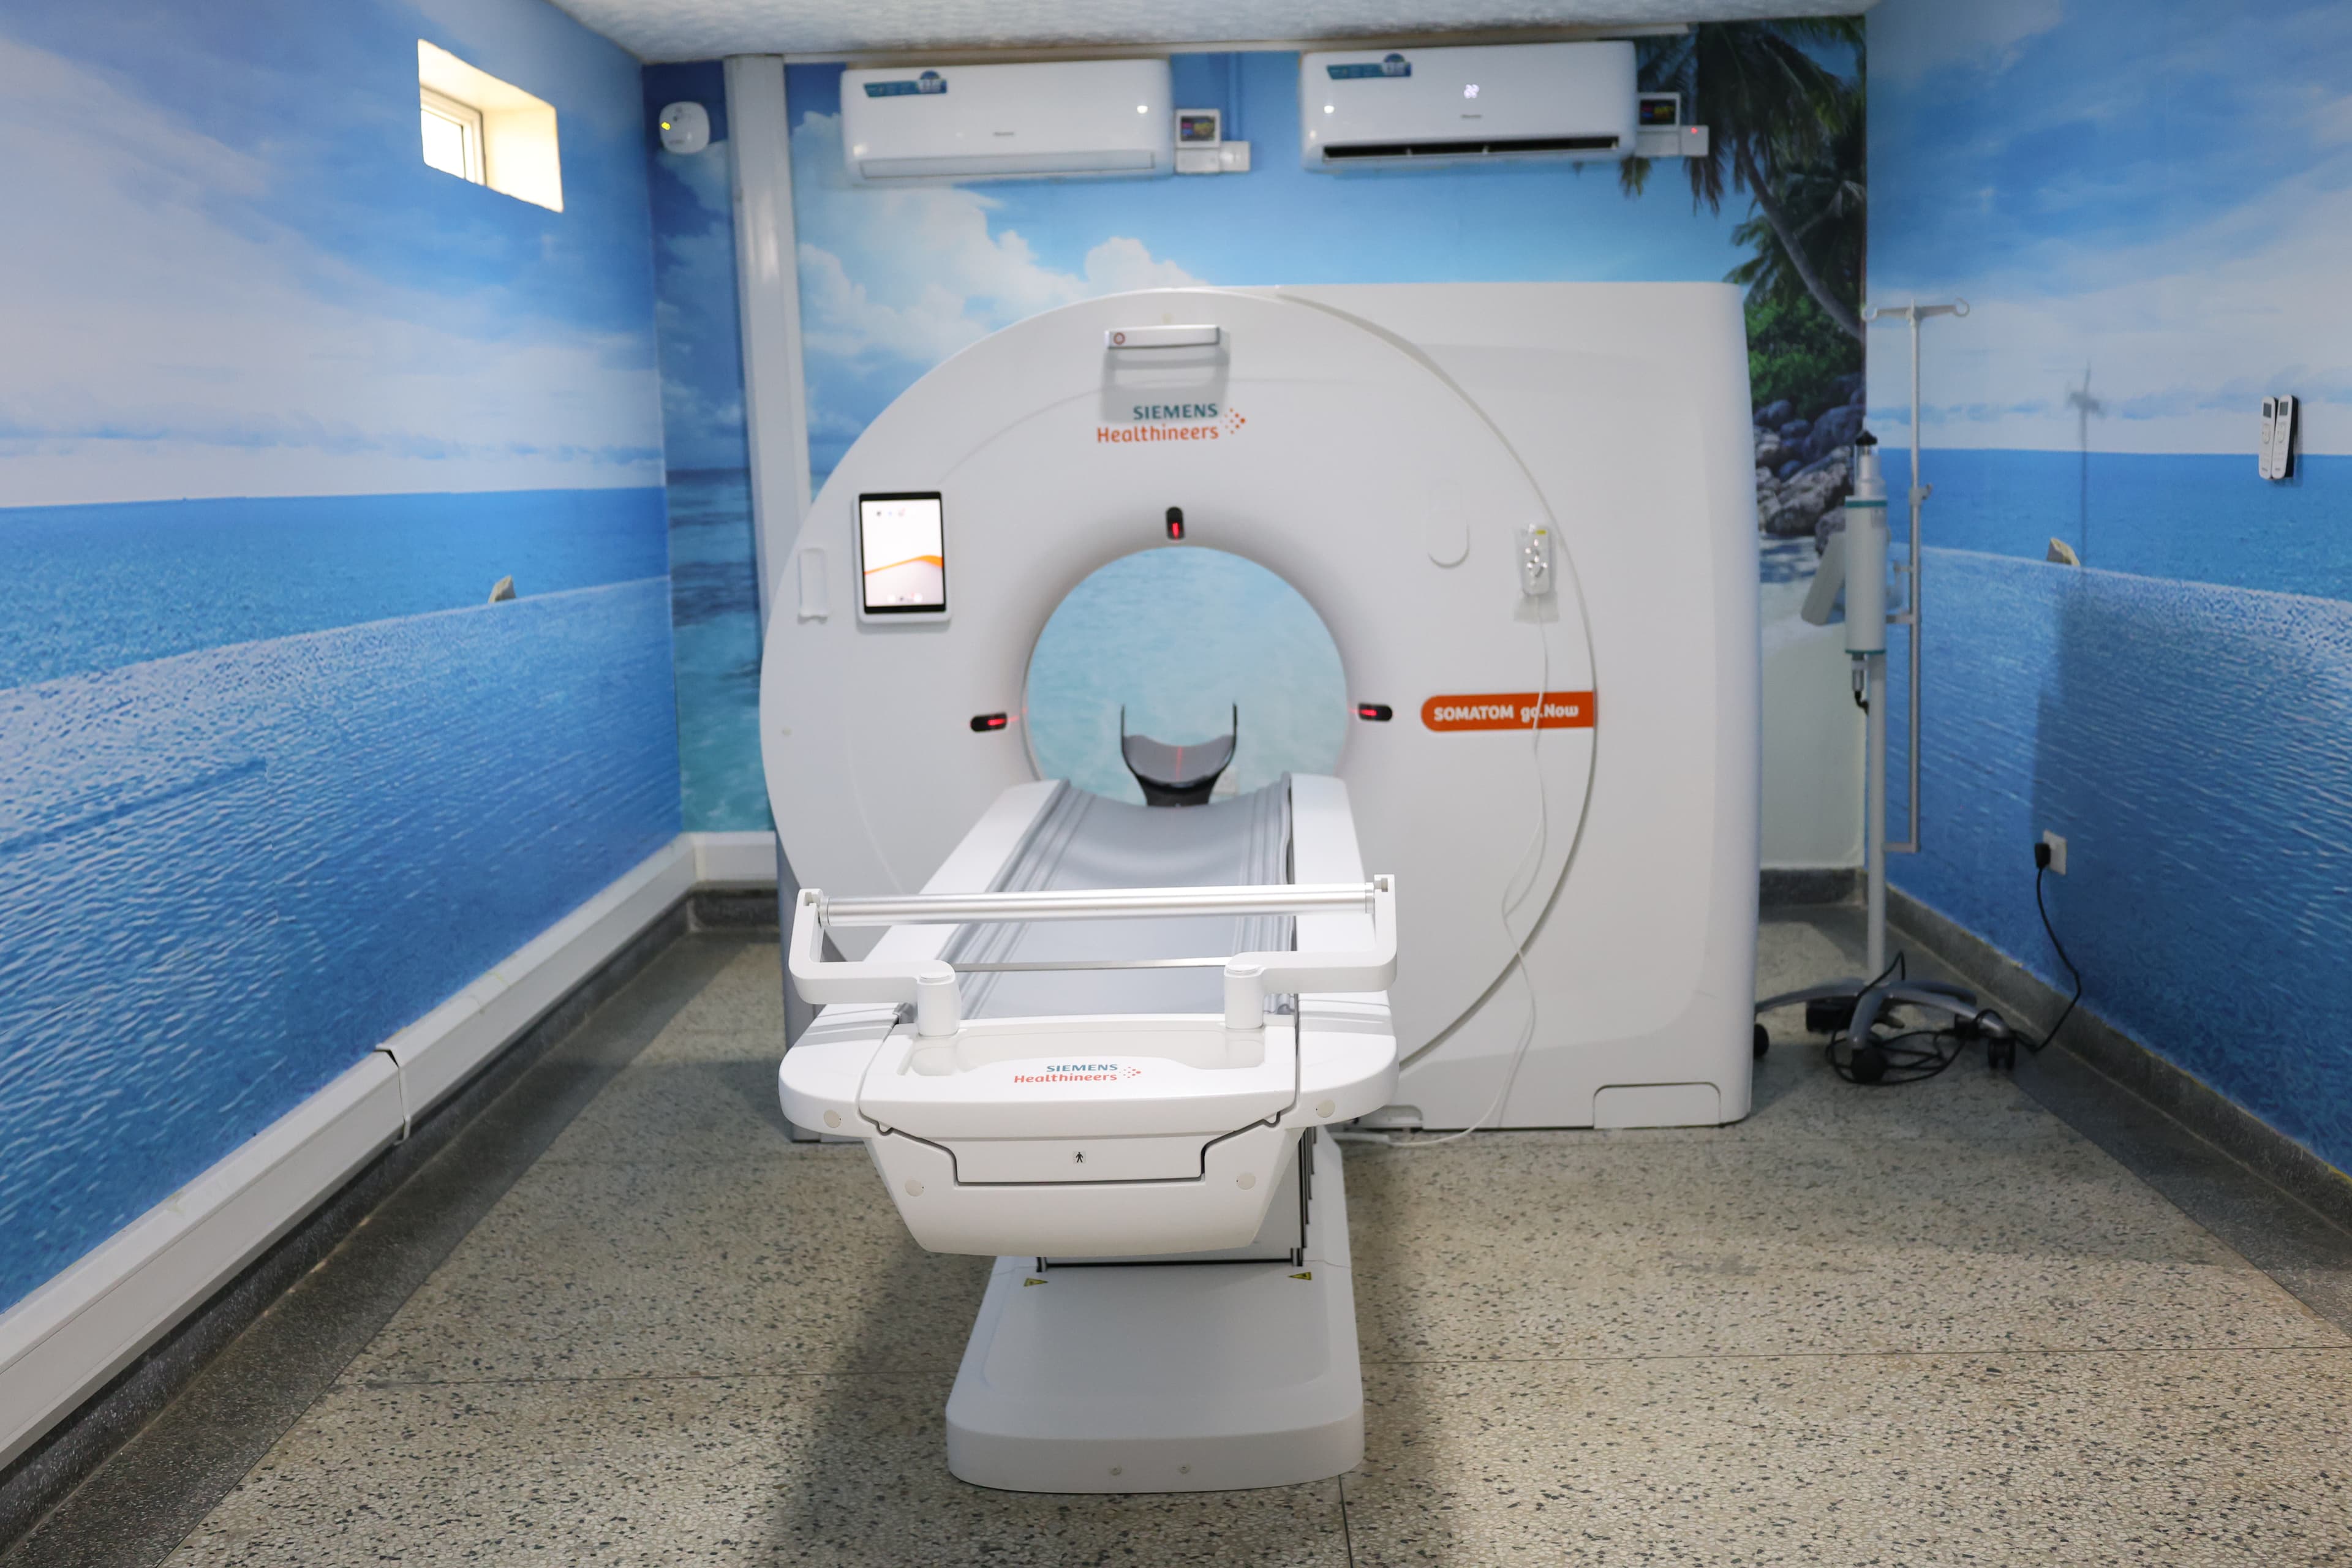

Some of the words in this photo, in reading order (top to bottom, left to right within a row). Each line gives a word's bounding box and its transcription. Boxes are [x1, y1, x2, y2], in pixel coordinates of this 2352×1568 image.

[1133, 403, 1218, 420] SIEMENS
[1097, 423, 1219, 443] Healthineers
[1434, 705, 1514, 721] SOMATOM
[1046, 1063, 1118, 1072] SIEMENS
[1014, 1073, 1117, 1083] Healthineers
